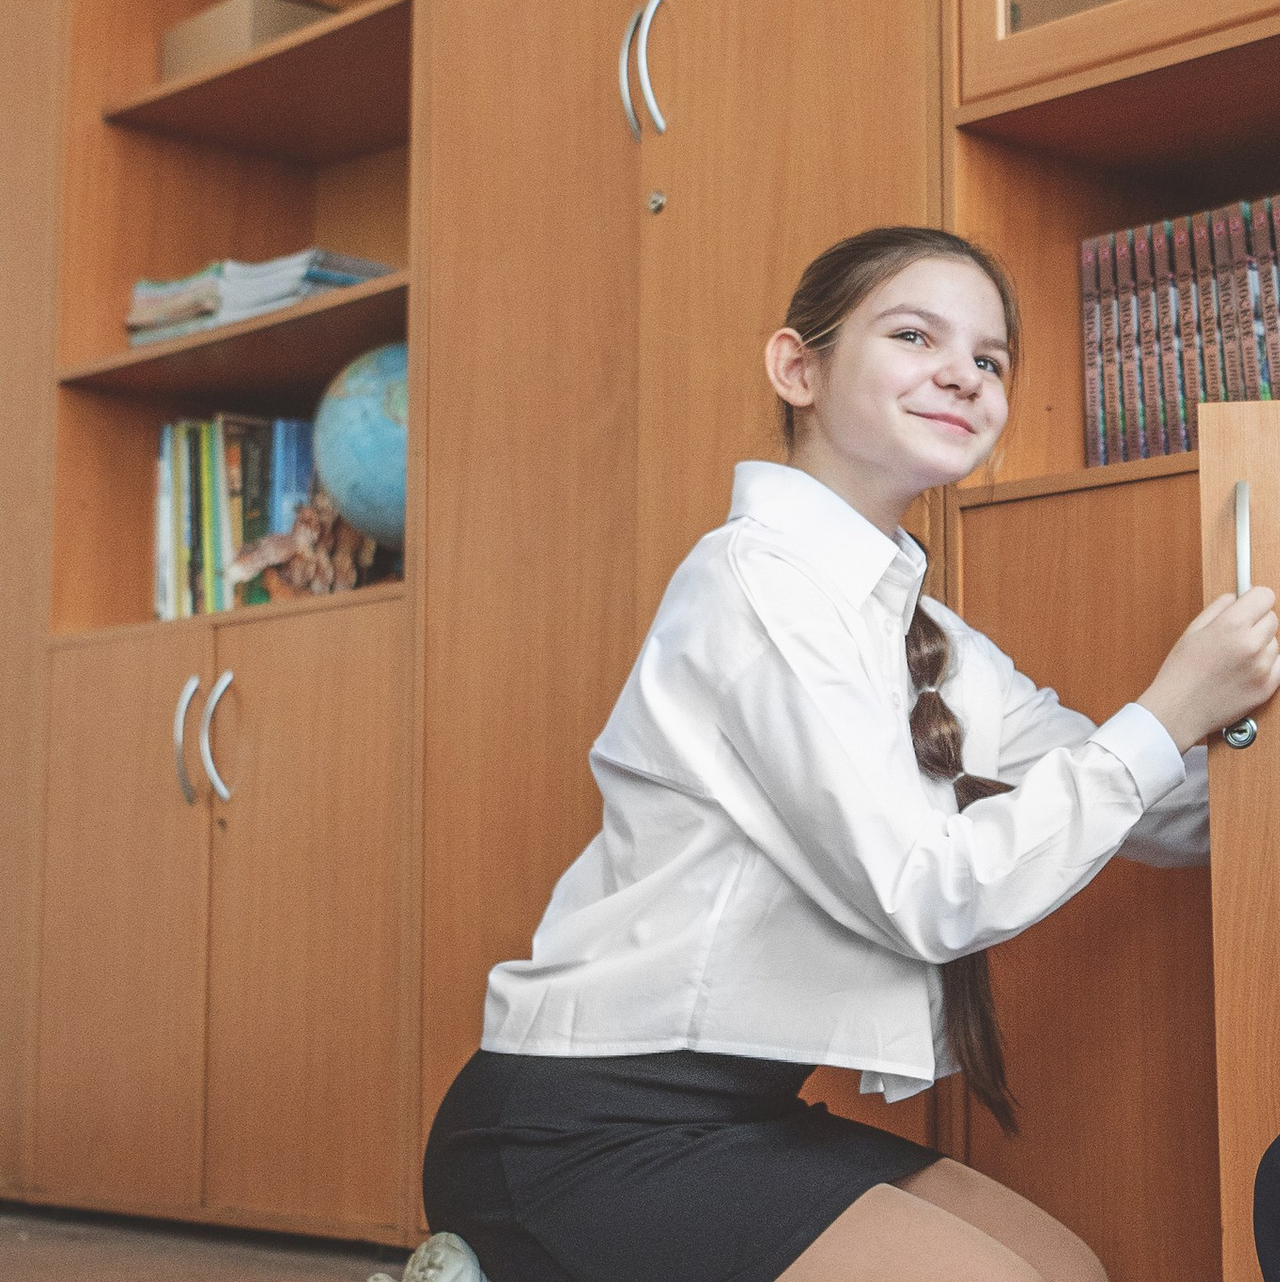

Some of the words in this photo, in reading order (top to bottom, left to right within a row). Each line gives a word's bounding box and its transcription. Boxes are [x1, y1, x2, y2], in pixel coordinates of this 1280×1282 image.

[1200, 283, 1216, 345] МОСКВЕ
[1218, 278, 1235, 343] МОСКВЕ
[1236, 274, 1253, 338] МОСКВЕ
[1260, 270, 1279, 334] МОСКВЕ
[1205, 353, 1220, 403] интер
